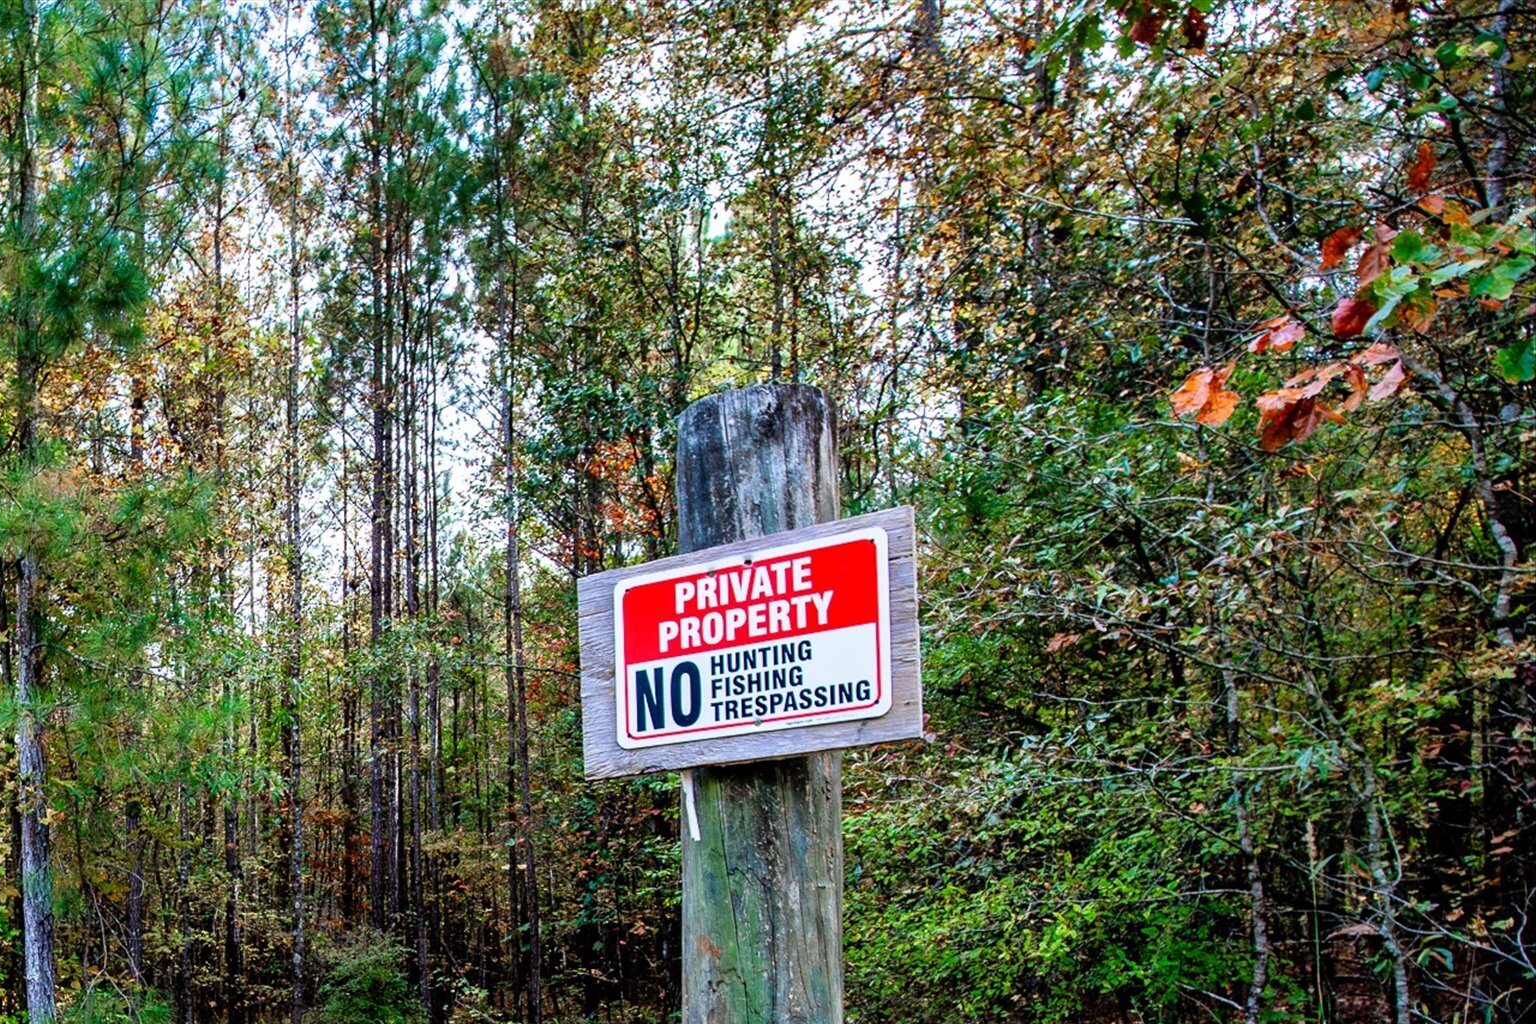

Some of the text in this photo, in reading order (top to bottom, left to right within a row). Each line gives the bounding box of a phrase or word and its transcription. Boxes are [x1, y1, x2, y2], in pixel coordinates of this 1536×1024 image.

[675, 556, 812, 614] PRIVATE
[658, 590, 834, 653] PROPERTY
[711, 640, 812, 676] HUNTING
[711, 666, 803, 699] FISHING
[635, 661, 702, 732] NO
[711, 680, 871, 722] TRESPASSING
